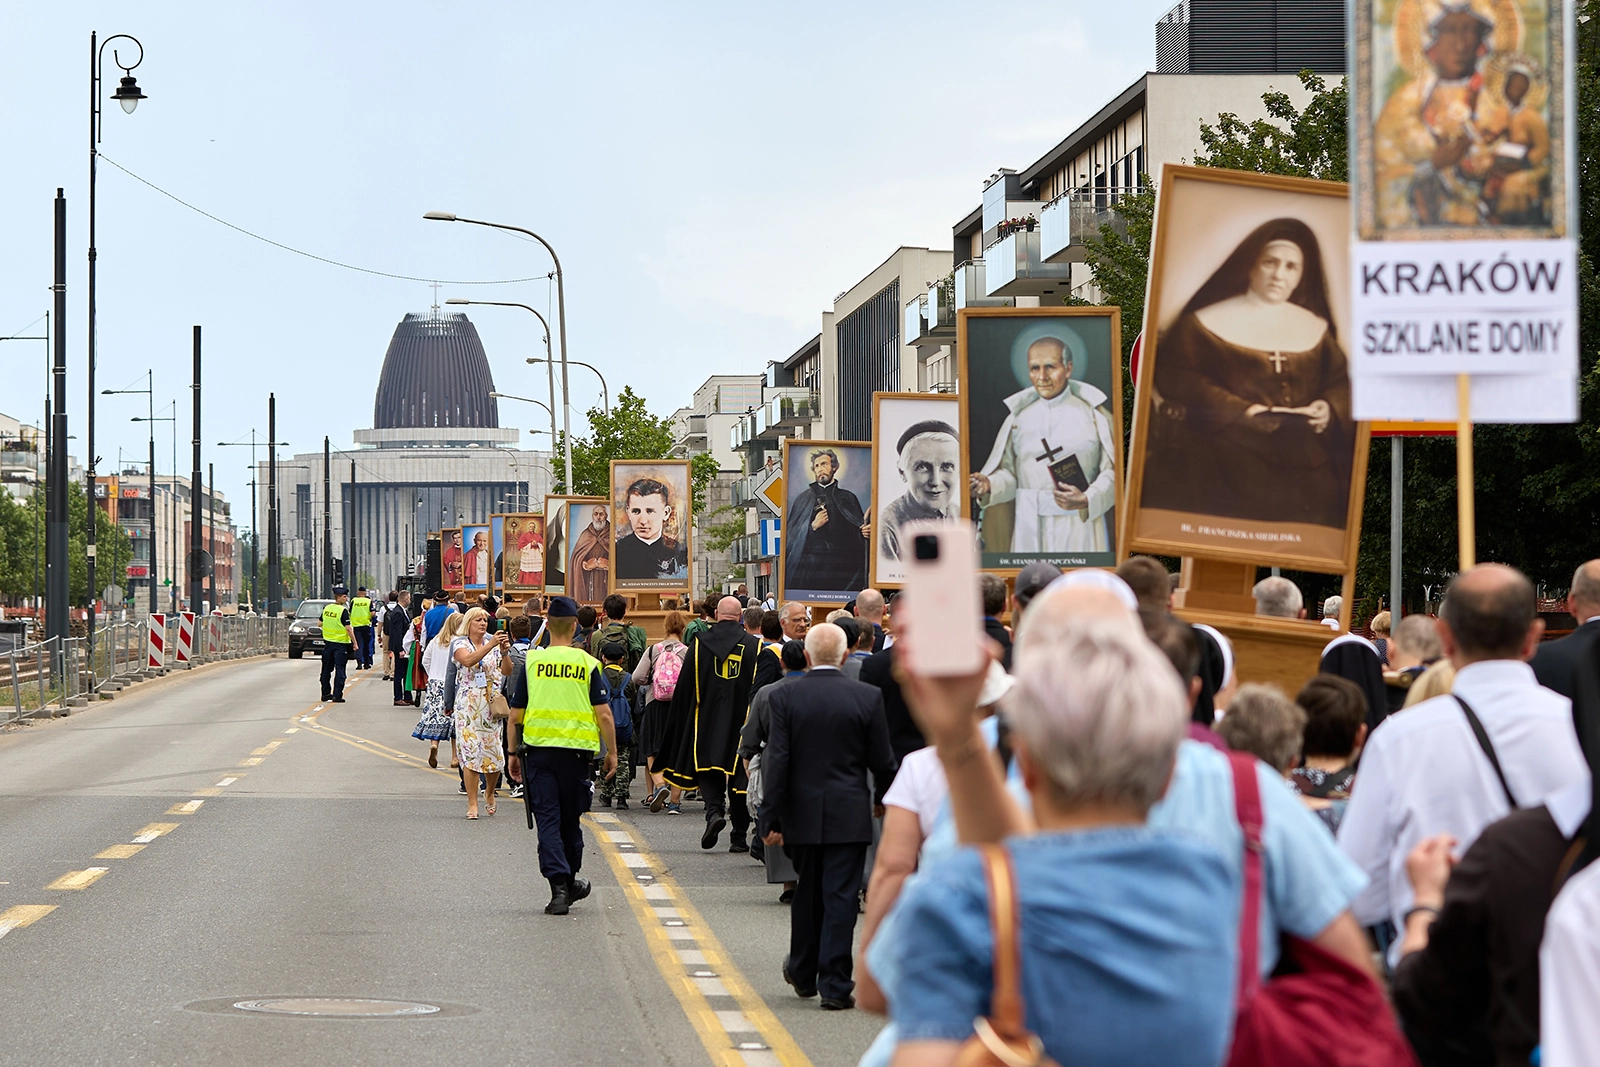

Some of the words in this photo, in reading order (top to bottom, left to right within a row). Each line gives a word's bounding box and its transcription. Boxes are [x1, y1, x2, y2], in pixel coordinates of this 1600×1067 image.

[1362, 252, 1561, 295] KRAKÓW
[1363, 321, 1480, 354] SZKLANE
[1489, 320, 1562, 354] DOMY
[1198, 525, 1254, 540] FRANCISZKA
[537, 663, 585, 681] POLICJA
